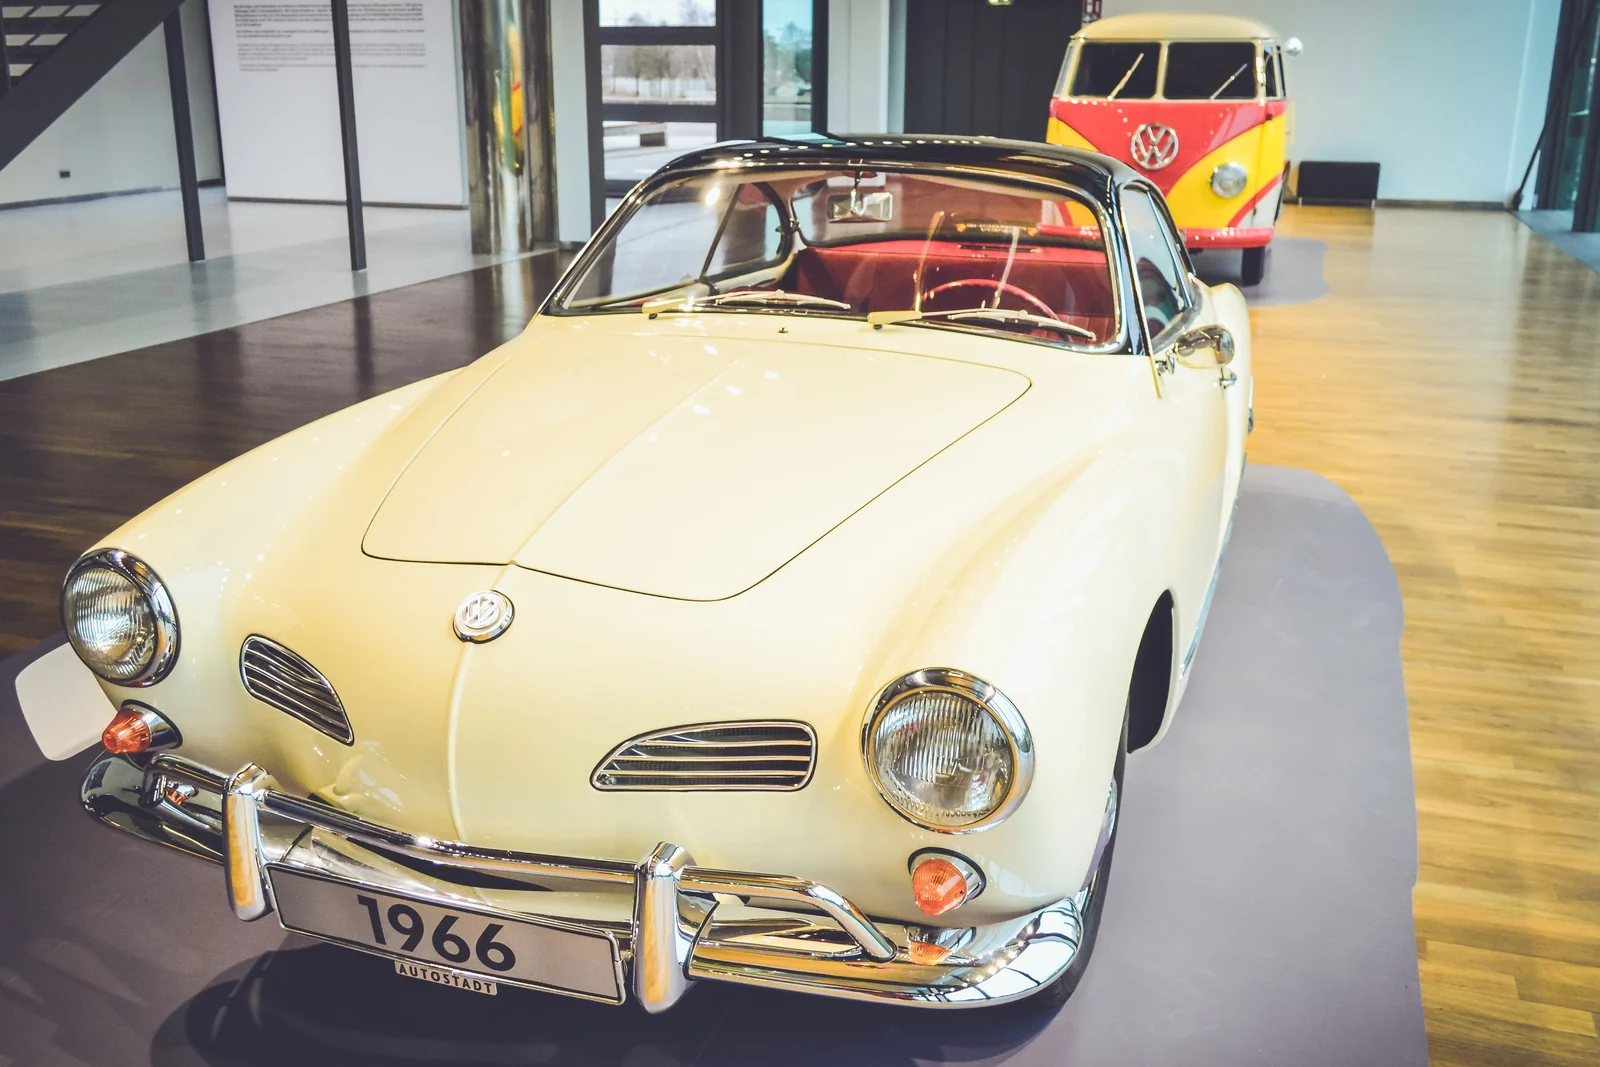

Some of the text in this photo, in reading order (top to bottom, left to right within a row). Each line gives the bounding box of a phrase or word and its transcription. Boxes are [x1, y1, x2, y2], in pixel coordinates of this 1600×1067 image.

[1131, 123, 1179, 170] VW
[357, 894, 516, 972] 1966
[398, 963, 493, 995] AUTOSTADT
